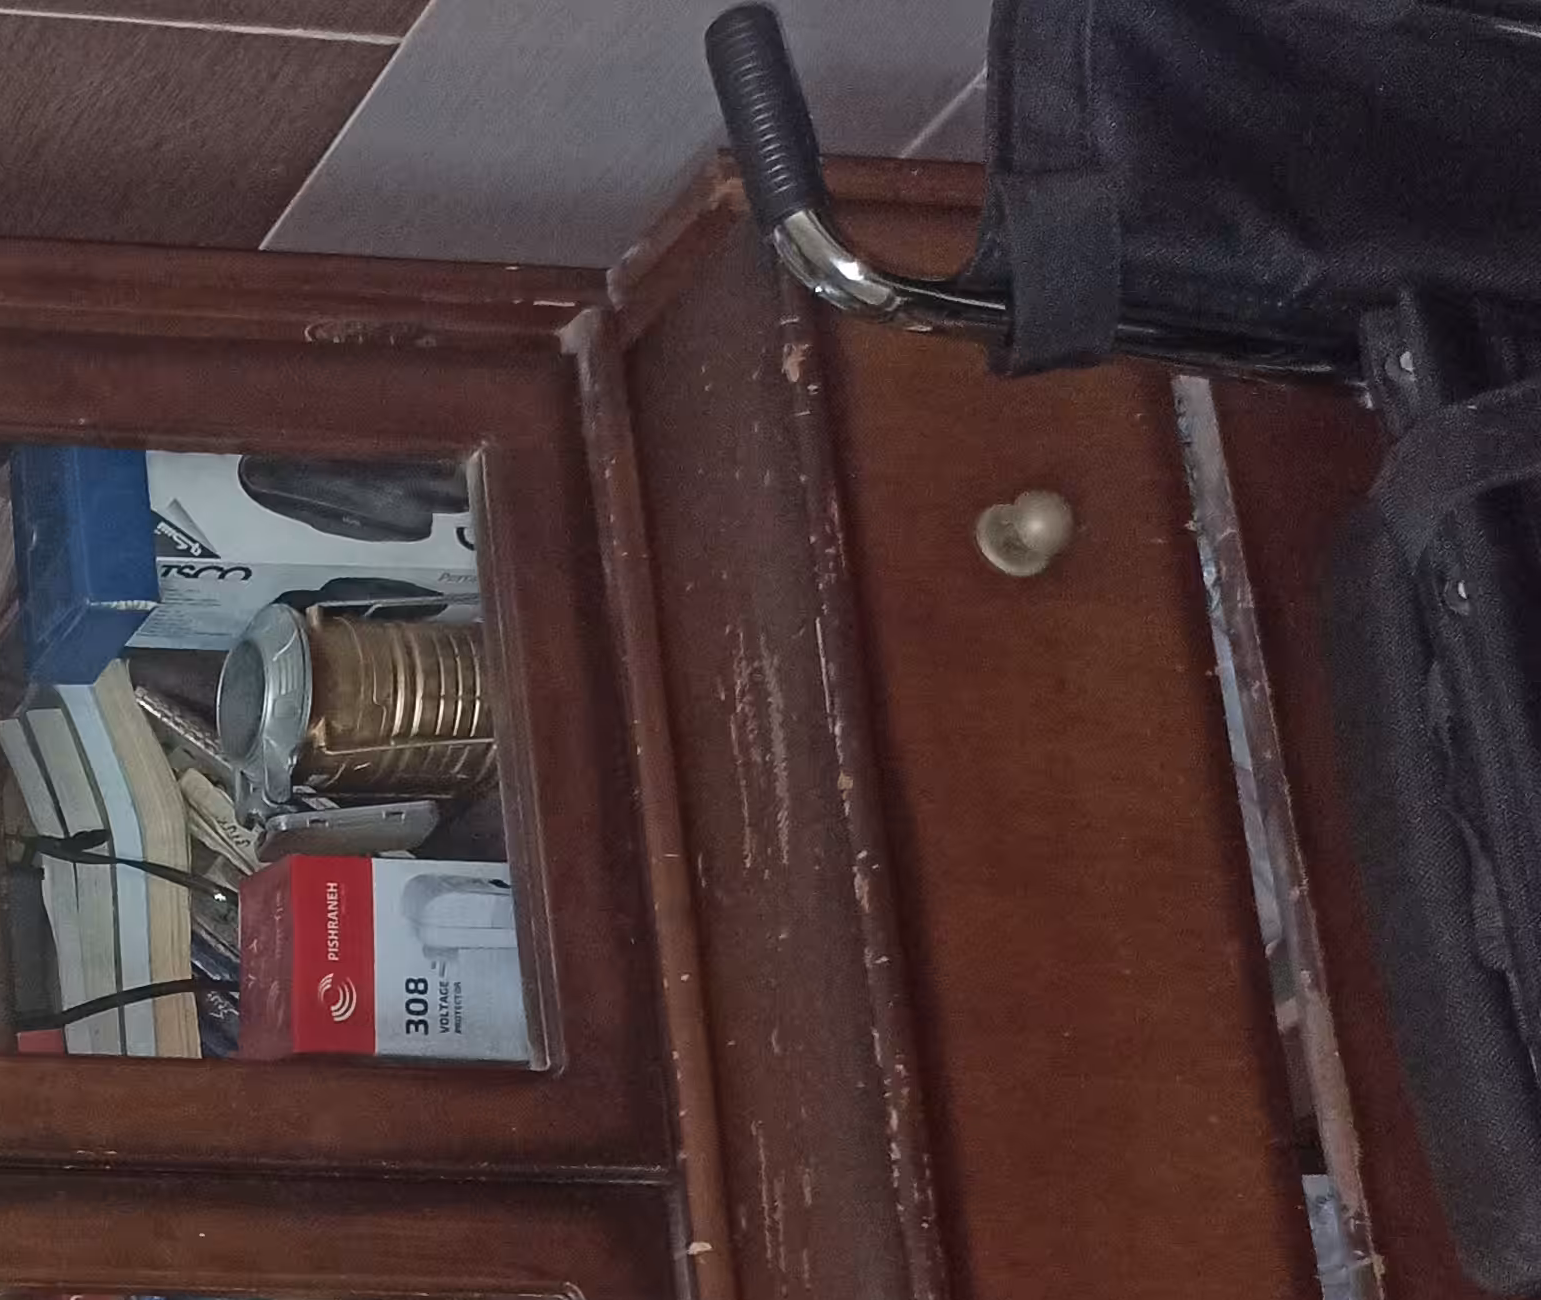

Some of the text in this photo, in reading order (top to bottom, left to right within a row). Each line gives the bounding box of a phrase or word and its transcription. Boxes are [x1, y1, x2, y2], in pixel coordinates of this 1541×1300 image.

[324, 881, 341, 962] PISHRANEH
[403, 976, 430, 1037] 308
[438, 980, 451, 1035] VOLTAGE
